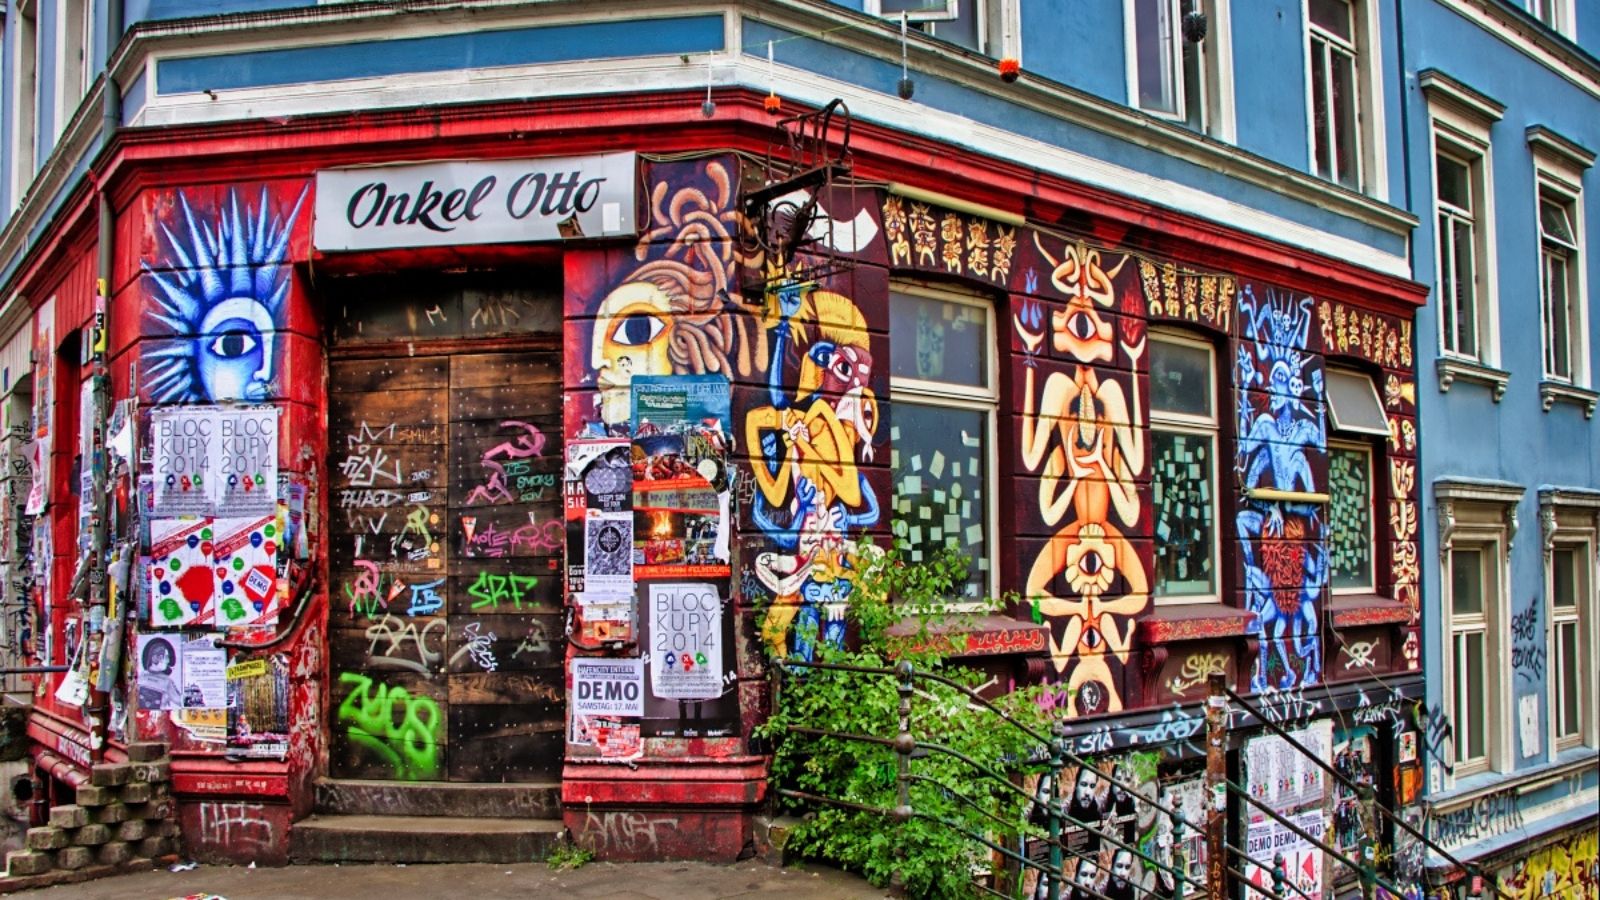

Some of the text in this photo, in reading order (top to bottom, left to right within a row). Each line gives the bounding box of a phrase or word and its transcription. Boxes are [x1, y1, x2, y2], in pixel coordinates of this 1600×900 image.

[346, 171, 607, 232] Onkel Otto
[160, 418, 212, 437] BLOC
[221, 418, 273, 437] BLOC
[160, 437, 212, 455] KUPY
[221, 437, 273, 455] KUPY
[159, 455, 210, 473] 2014
[220, 455, 273, 474] 2014
[249, 575, 267, 594] DEMO
[656, 592, 715, 612] BLOC
[656, 613, 716, 631] KUPY
[656, 632, 715, 651] 2014
[578, 681, 639, 701] DEMO
[1274, 831, 1297, 848] DEMO
[1300, 823, 1321, 841] EMO
[1249, 835, 1272, 853] DEMO
